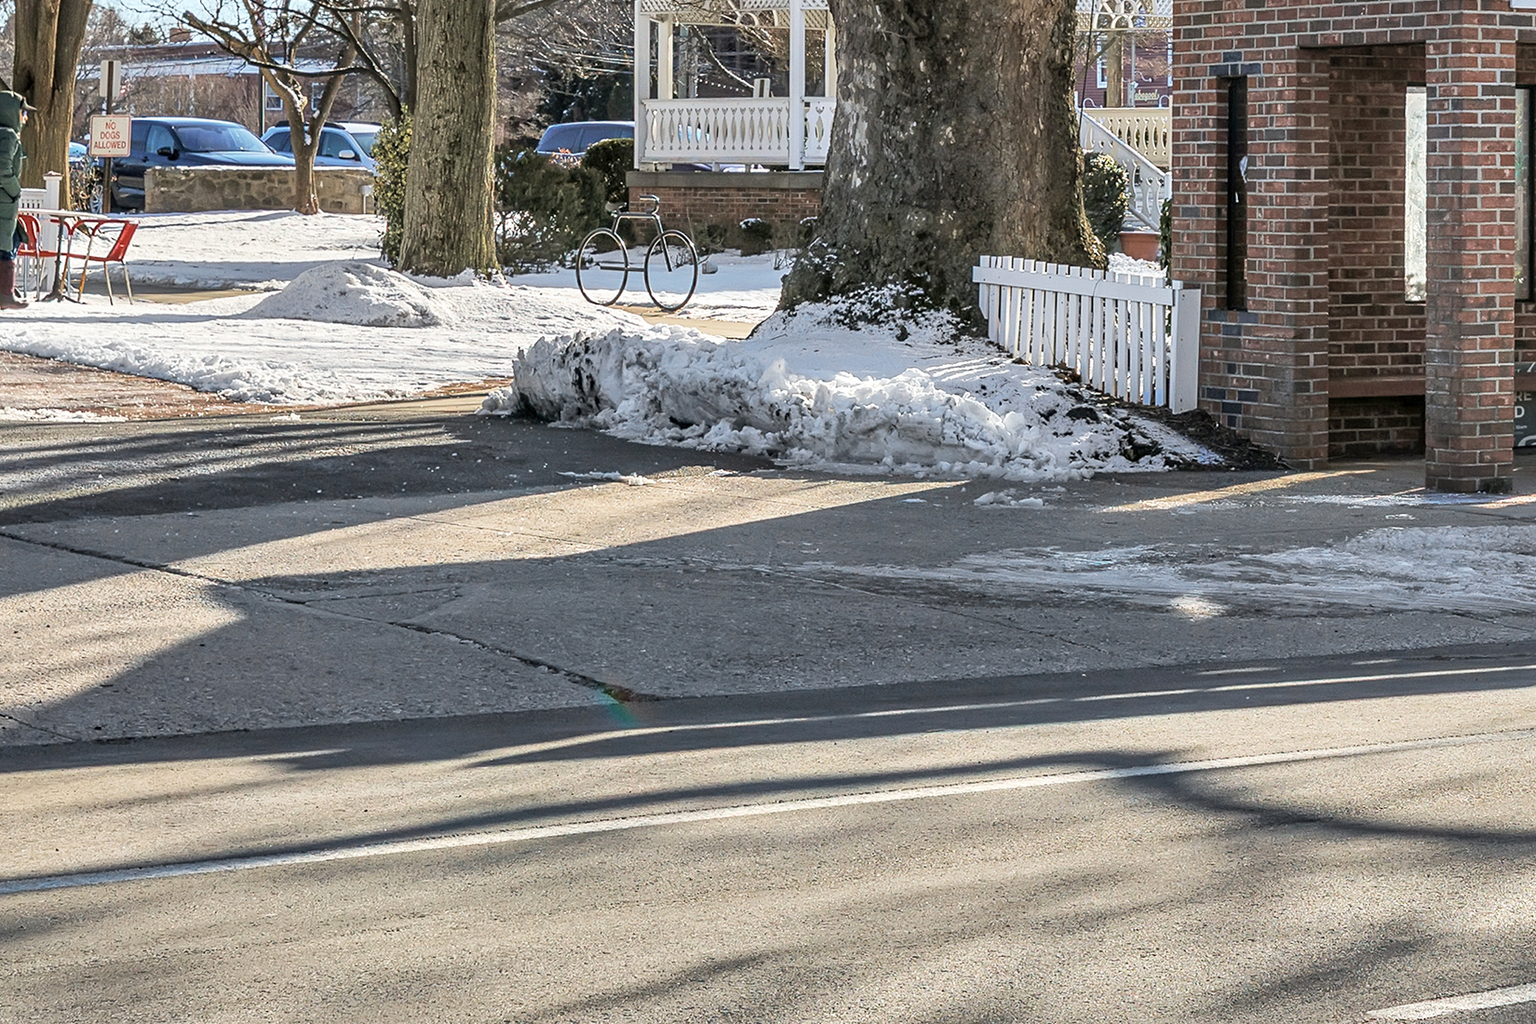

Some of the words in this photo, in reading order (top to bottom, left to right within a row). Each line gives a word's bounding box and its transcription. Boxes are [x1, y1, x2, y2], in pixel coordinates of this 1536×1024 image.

[105, 122, 116, 130] NO
[100, 131, 121, 140] DOGS
[93, 140, 127, 149] ALLOWED
